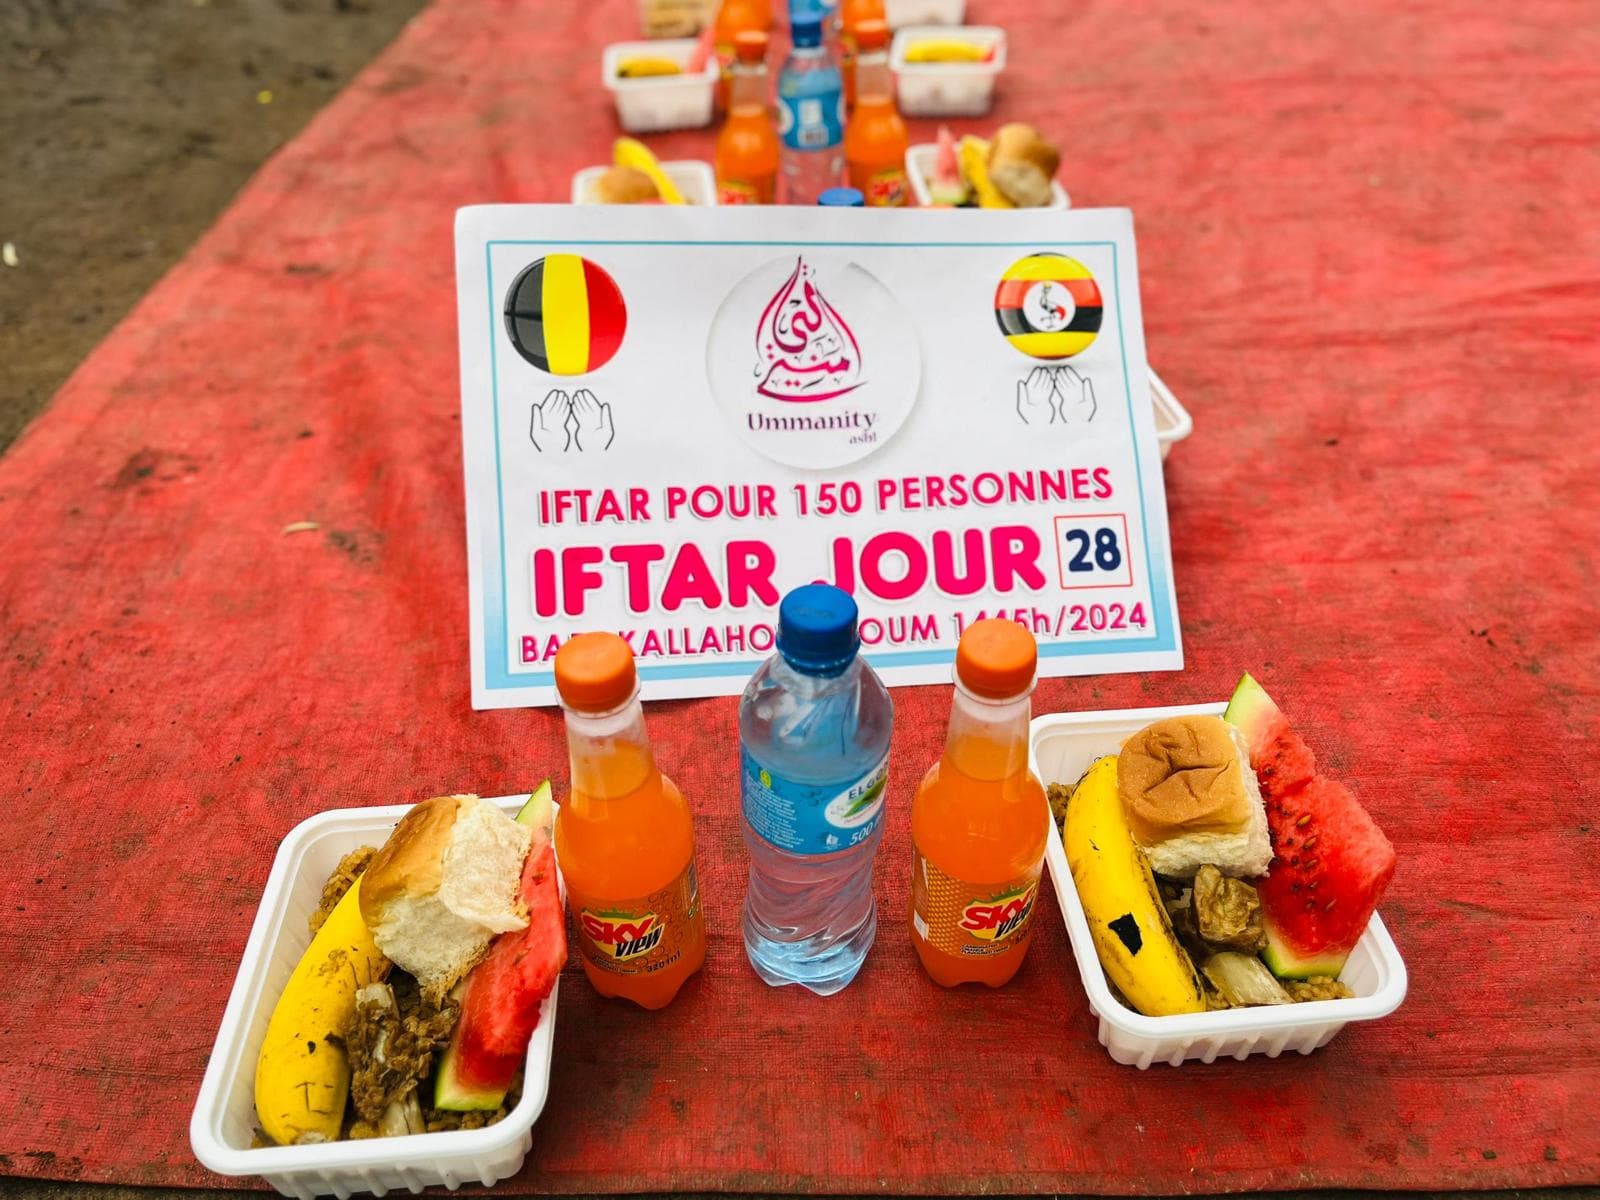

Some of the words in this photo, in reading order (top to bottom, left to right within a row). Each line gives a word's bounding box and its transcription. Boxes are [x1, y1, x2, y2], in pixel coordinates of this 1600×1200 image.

[748, 410, 876, 431] Ummanity
[539, 488, 651, 524] IFTAR
[667, 484, 777, 519] POUR
[794, 481, 862, 516] 150
[877, 467, 1114, 511] PERSONNES
[534, 540, 780, 617] IFTAR
[808, 525, 1047, 601] JOUR
[1065, 528, 1122, 572] 28
[849, 821, 874, 846] 500
[580, 914, 656, 945] SKY
[961, 884, 1037, 932] SKY
